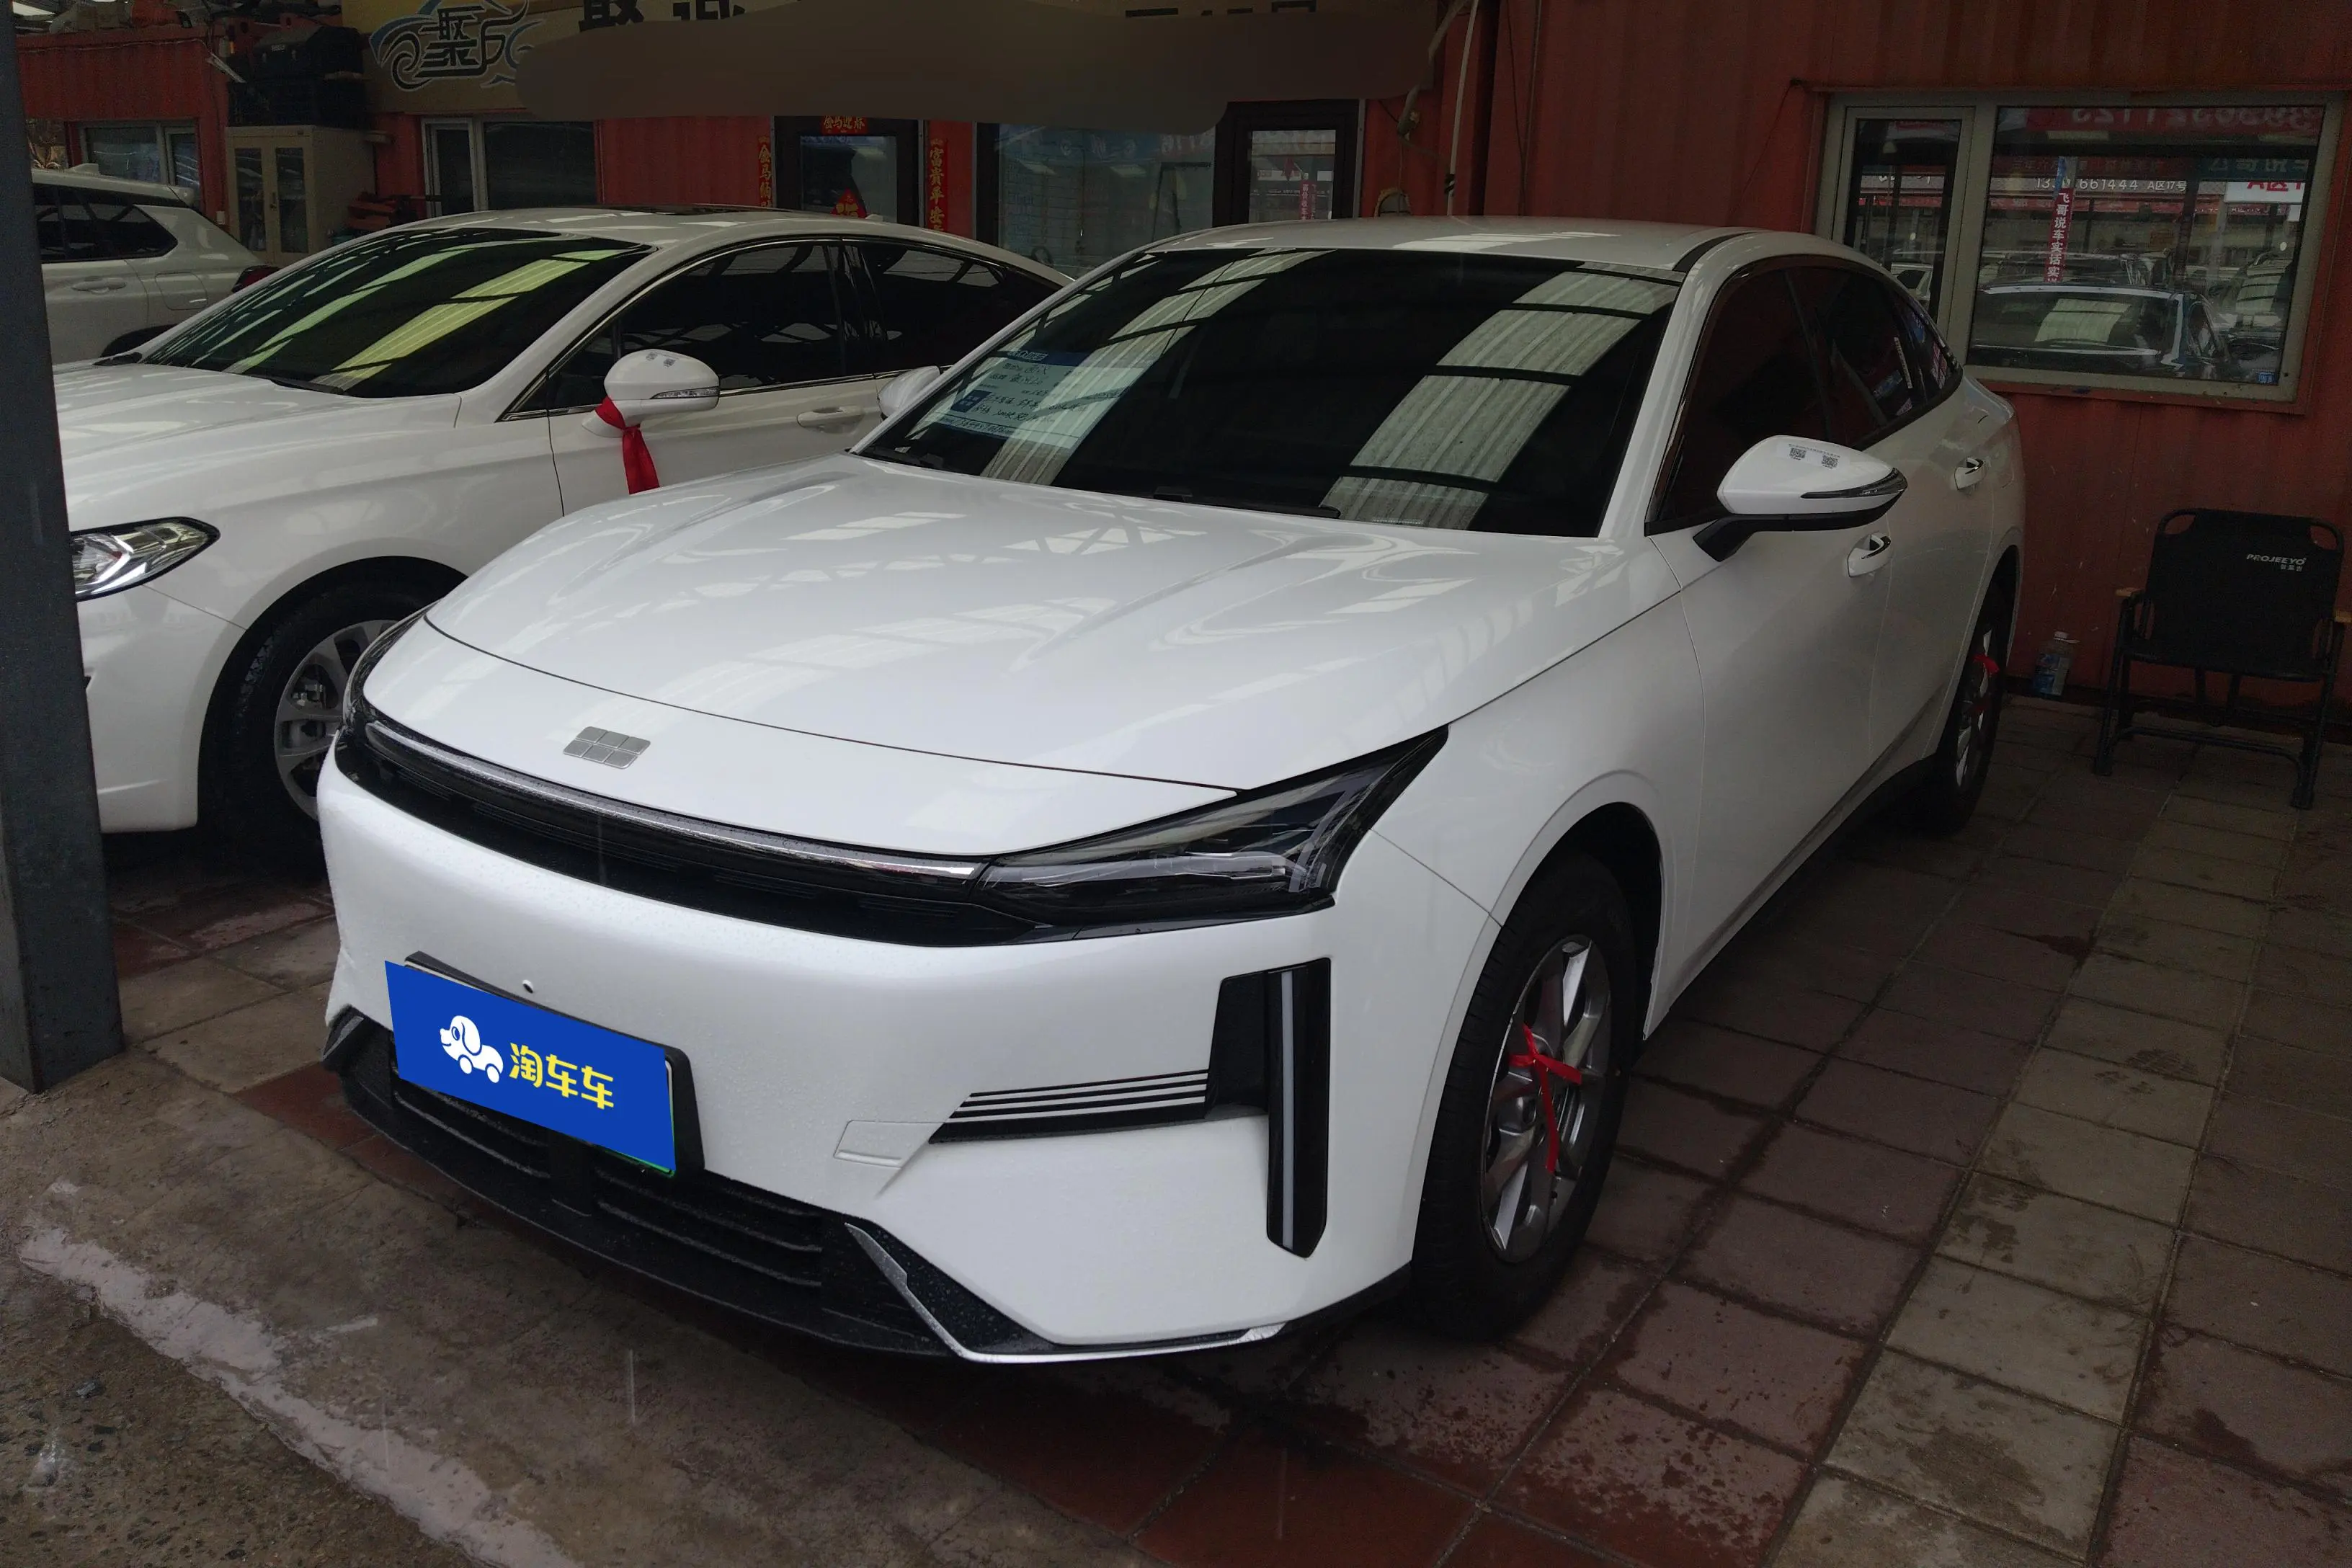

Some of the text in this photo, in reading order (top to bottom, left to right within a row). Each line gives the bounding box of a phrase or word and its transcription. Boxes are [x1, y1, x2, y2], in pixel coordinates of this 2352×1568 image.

[2047, 192, 2070, 282] 飞哥说车实话实
[2246, 553, 2306, 565] PROJEEYO
